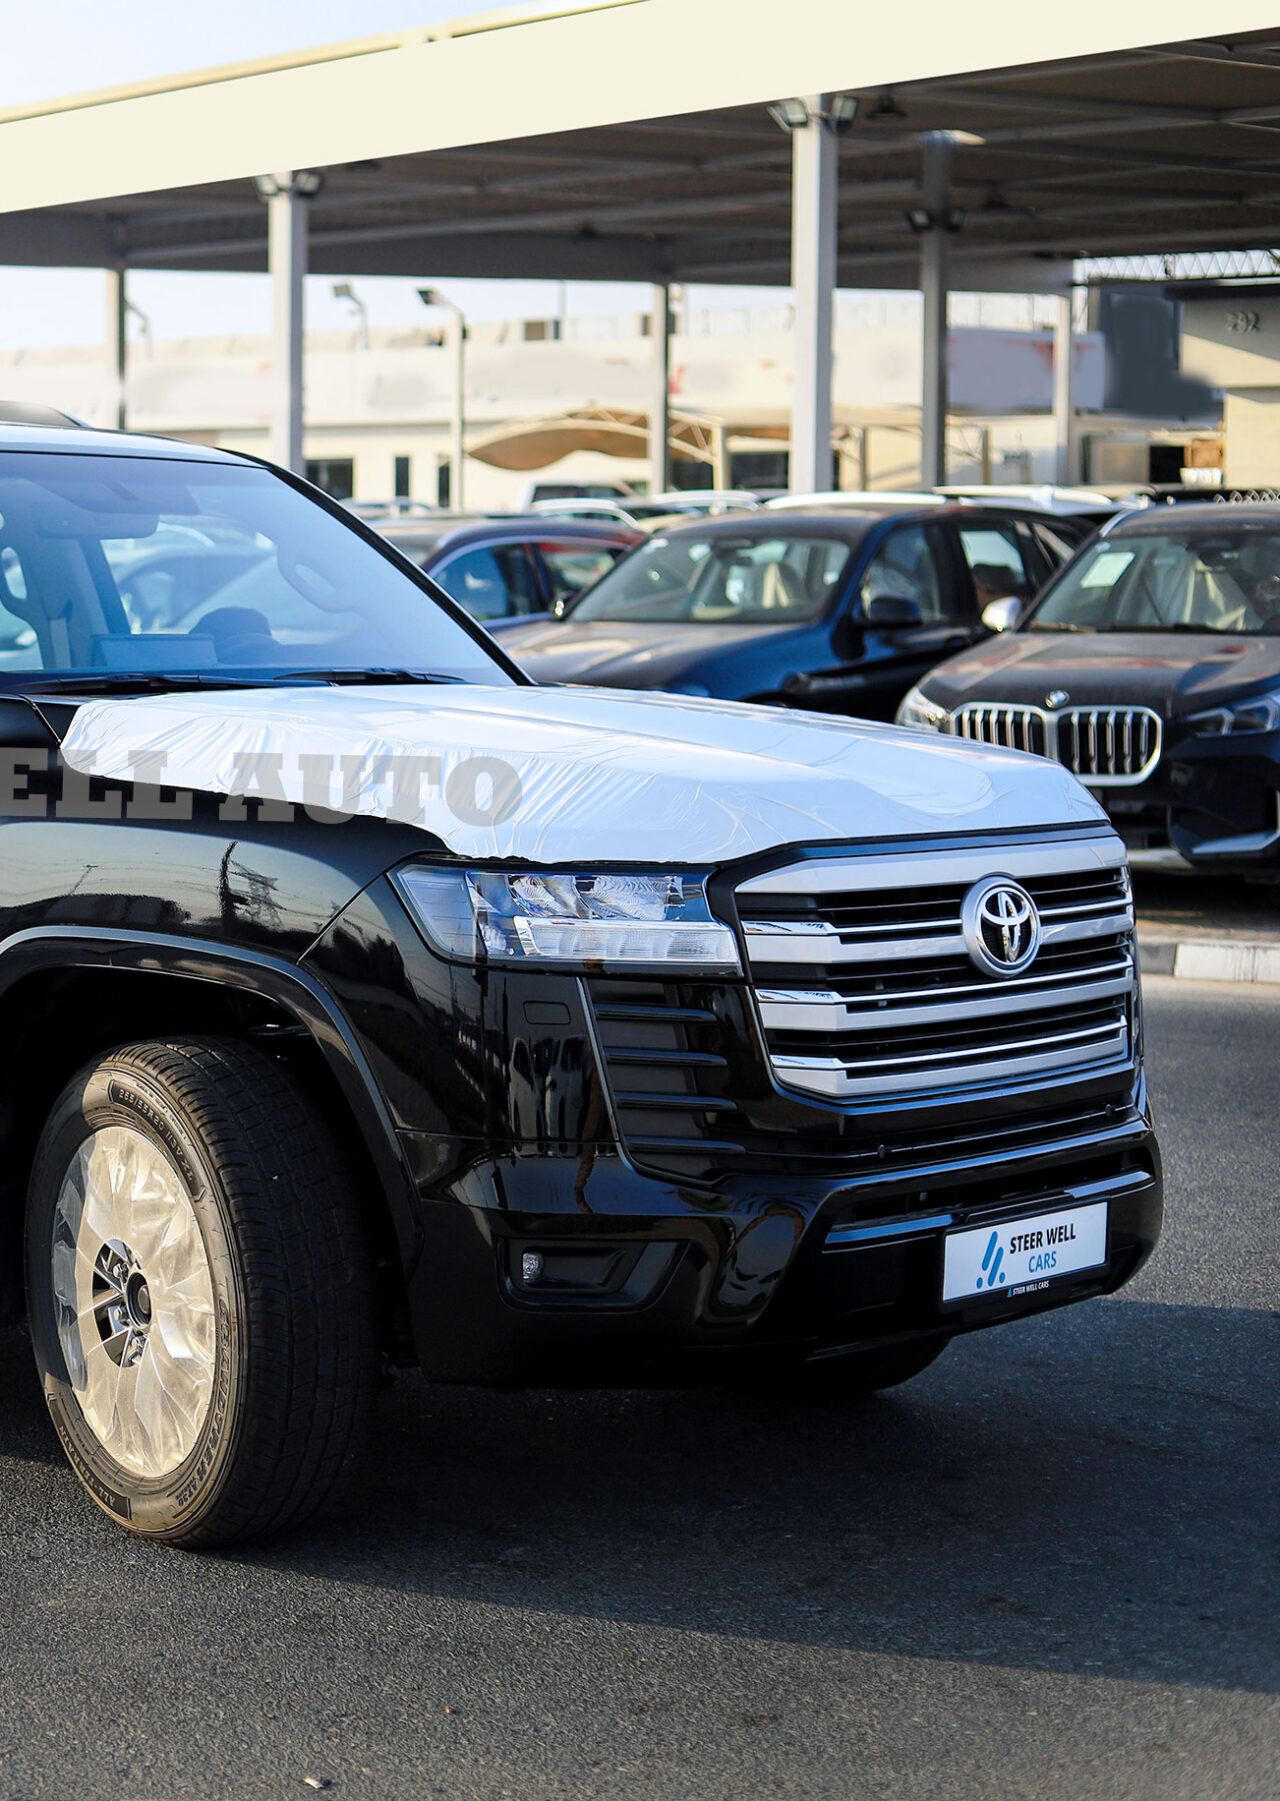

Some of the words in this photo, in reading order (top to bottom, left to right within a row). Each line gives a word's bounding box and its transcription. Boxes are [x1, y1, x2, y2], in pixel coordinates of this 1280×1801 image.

[1010, 1232, 1043, 1254] STEER
[1047, 1223, 1076, 1246] WELL
[1028, 1251, 1057, 1273] CARS
[1038, 1280, 1050, 1290] CARS
